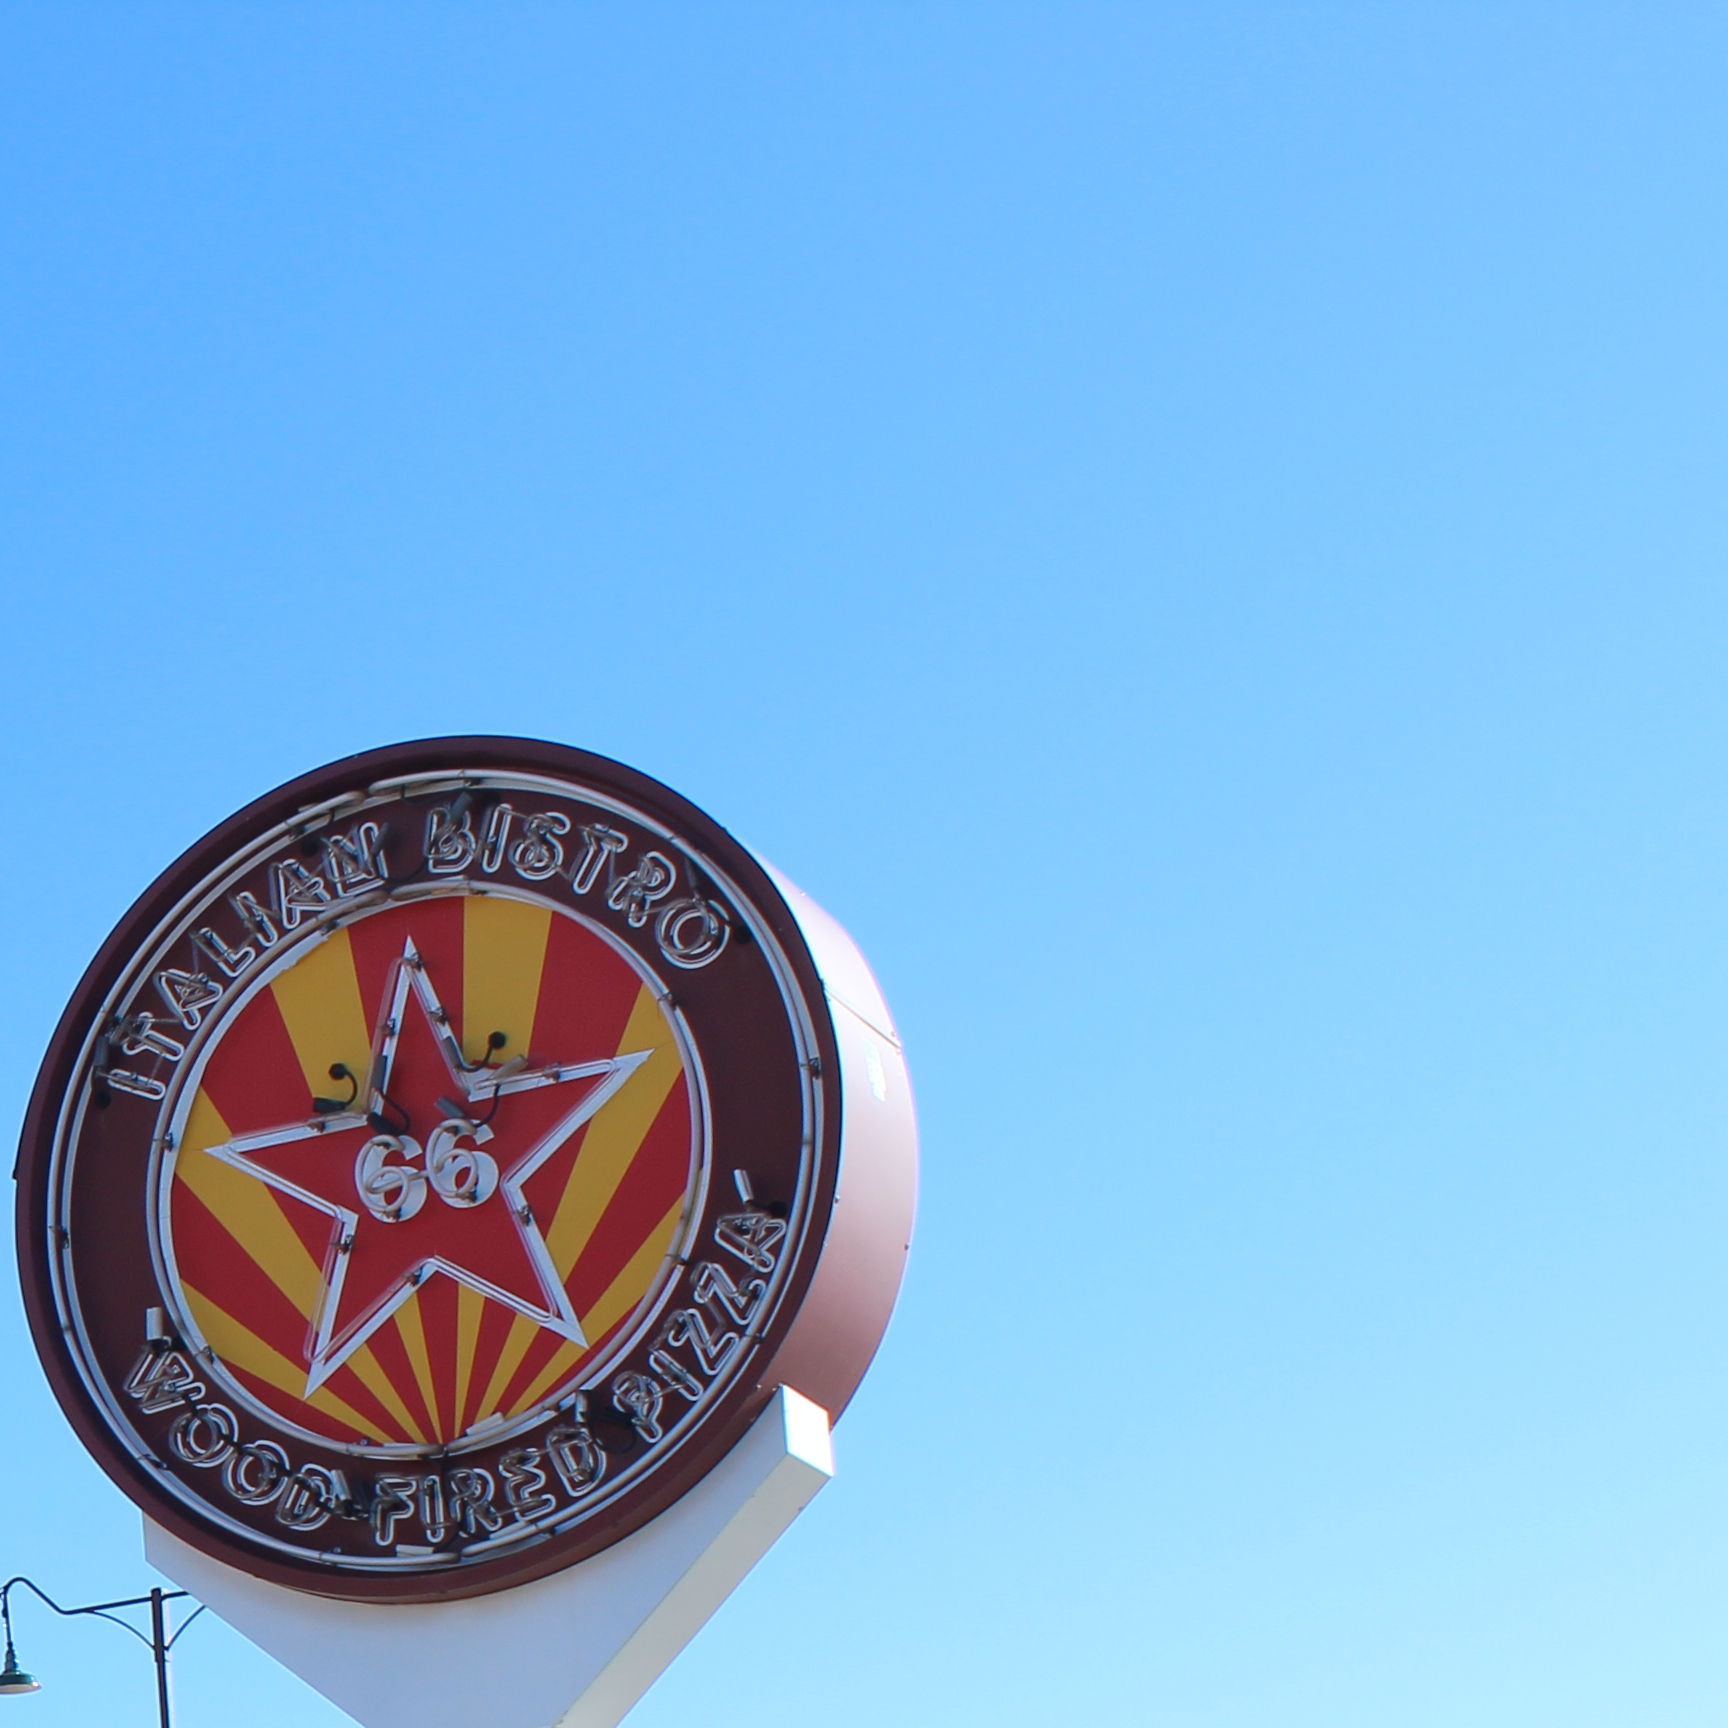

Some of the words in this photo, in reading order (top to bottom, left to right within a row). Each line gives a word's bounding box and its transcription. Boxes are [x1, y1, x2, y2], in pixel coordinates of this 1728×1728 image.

[104, 817, 391, 1102] ITALIAN
[424, 798, 734, 971] BISTRO
[352, 1115, 501, 1224] 66
[122, 1342, 336, 1532] WOOD
[369, 1428, 606, 1546] FIRED
[610, 1205, 790, 1445] PIZZA
